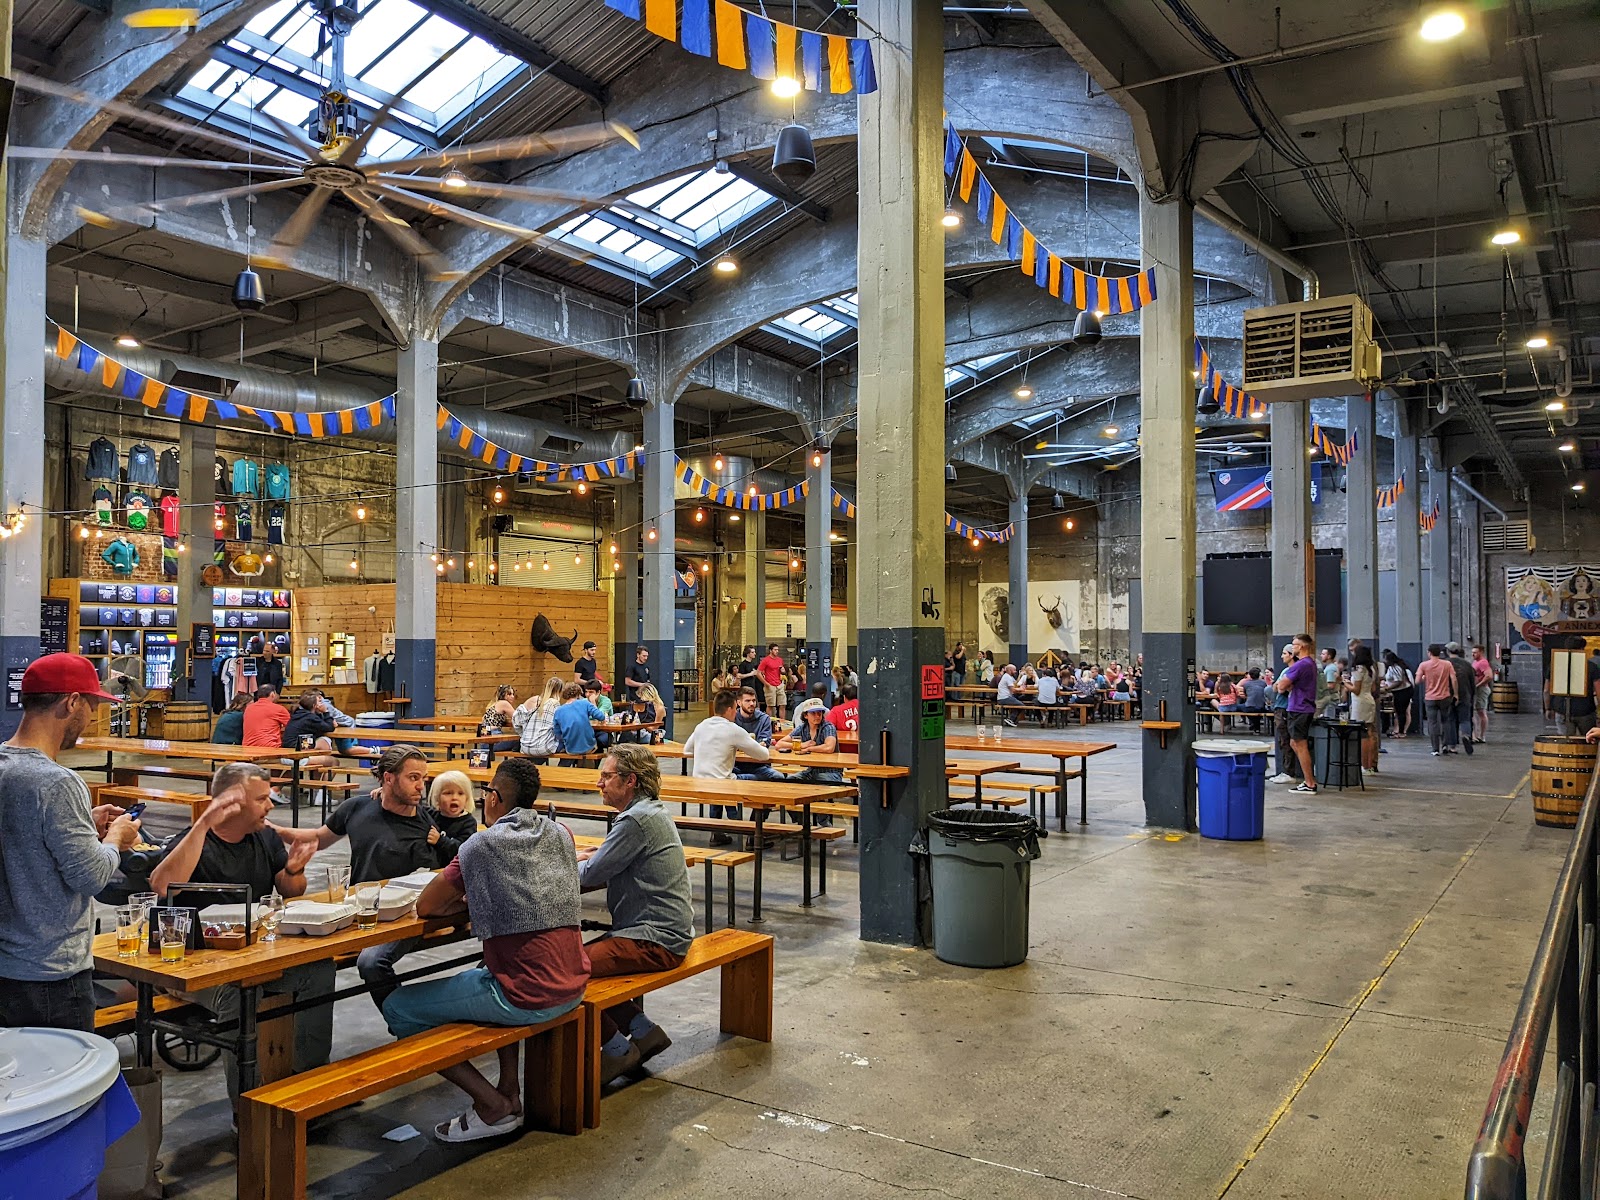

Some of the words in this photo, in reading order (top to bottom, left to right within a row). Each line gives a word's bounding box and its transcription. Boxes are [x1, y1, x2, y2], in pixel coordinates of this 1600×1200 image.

[271, 516, 282, 527] 22
[1565, 621, 1600, 630] ANNEX
[843, 707, 859, 719] PHA
